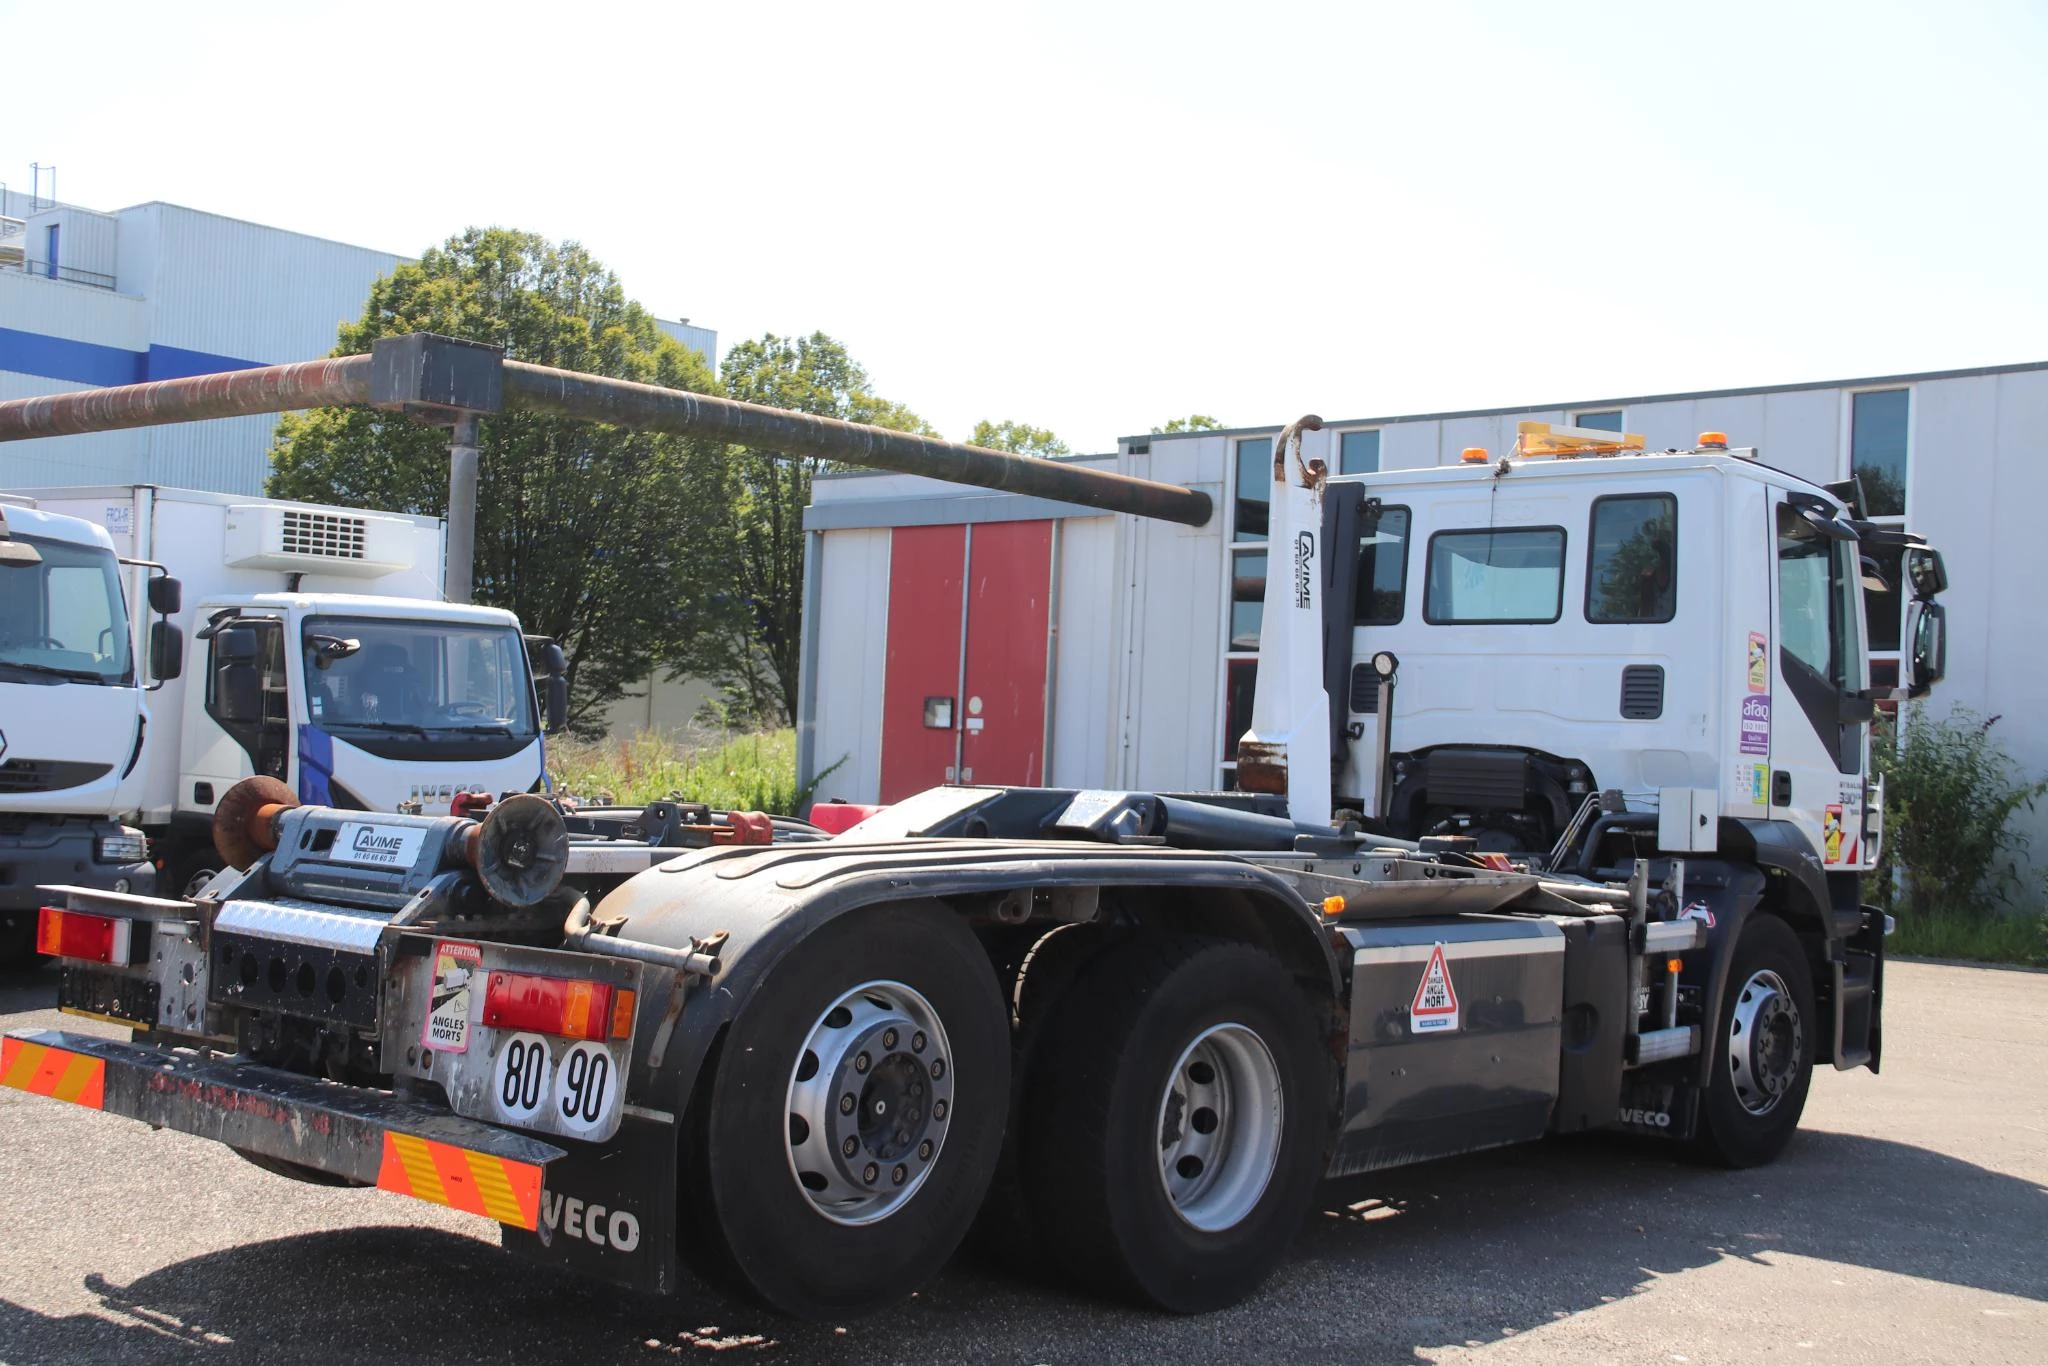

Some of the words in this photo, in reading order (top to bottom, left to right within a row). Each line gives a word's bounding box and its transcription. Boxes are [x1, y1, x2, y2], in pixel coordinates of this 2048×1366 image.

[1298, 531, 1315, 609] CAVIME
[352, 826, 404, 855] CAVIME
[388, 855, 397, 863] 35
[440, 943, 481, 959] ATTENTION
[1426, 984, 1444, 995] ANGLE
[1424, 995, 1445, 1008] MORT
[432, 1015, 465, 1030] ANGLES
[432, 1027, 461, 1042] MORTS
[502, 1039, 545, 1110] 80
[562, 1048, 609, 1123] 90
[1619, 1107, 1671, 1127] VECO
[542, 1190, 640, 1252] VECO
